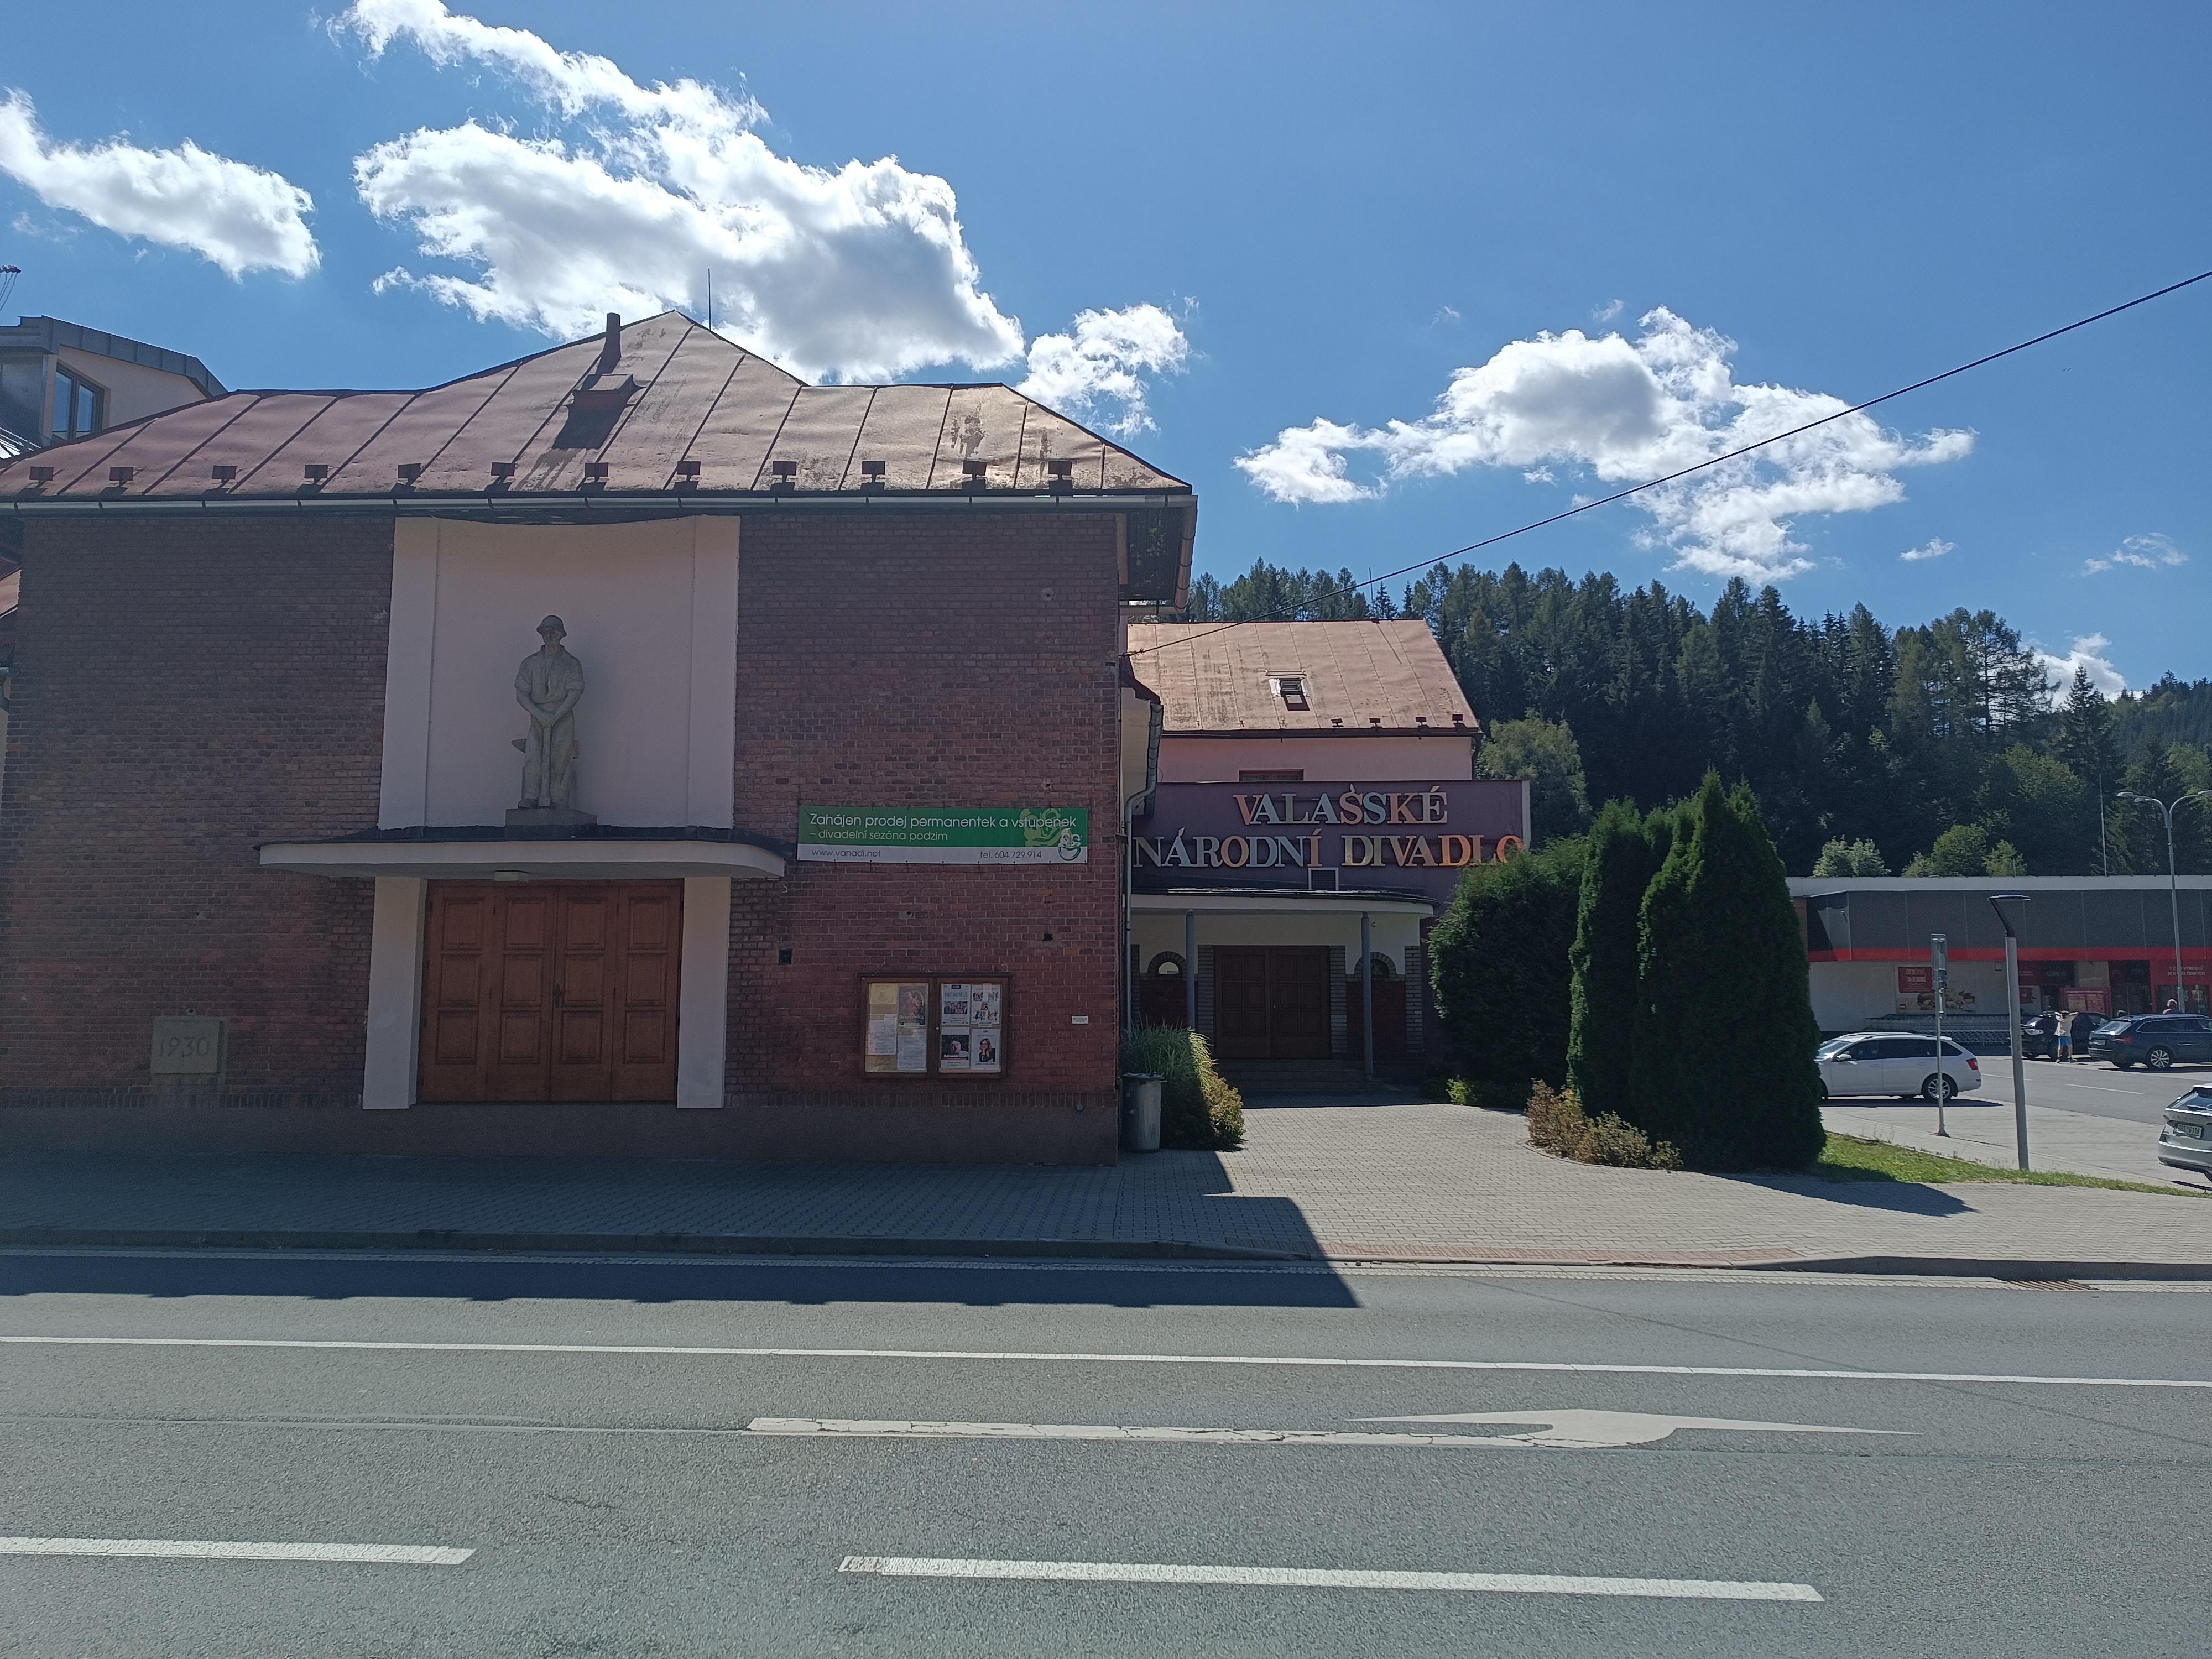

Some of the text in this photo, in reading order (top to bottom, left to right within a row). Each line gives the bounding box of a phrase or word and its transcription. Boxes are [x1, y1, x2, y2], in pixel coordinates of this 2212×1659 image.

[810, 813, 1076, 829] Zahájen prodej permanentek a vstupenek
[818, 830, 867, 839] divadelní
[869, 831, 906, 840] sezóna
[909, 831, 947, 842] podzim
[1133, 827, 1322, 868] NÁRODNÍ
[160, 1036, 209, 1057] 1930
